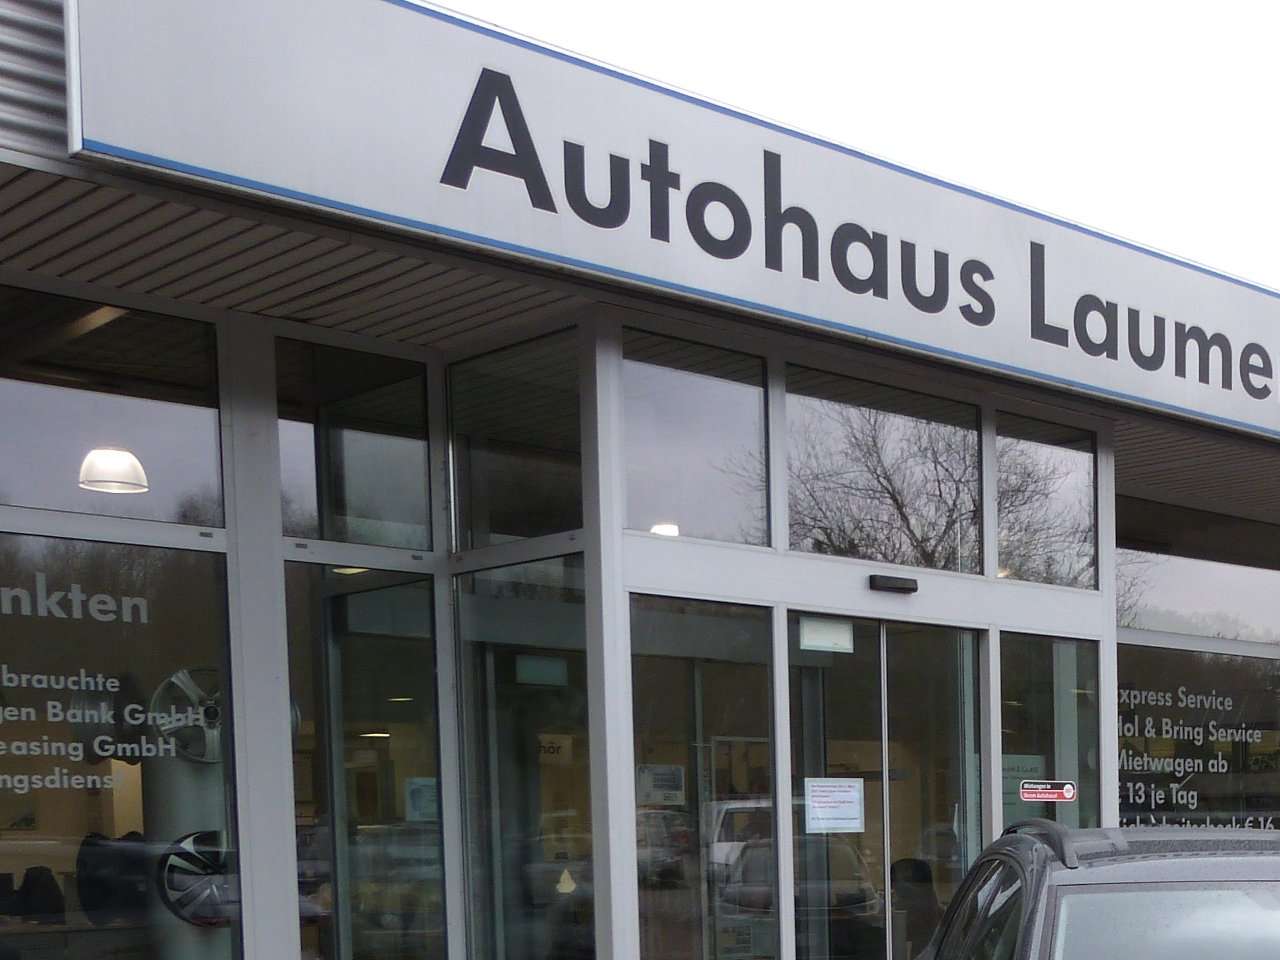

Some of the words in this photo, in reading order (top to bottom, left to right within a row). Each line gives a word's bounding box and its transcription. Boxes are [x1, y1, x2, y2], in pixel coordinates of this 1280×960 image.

[439, 67, 996, 327] Autohaus
[0, 572, 148, 623] nkten
[2, 664, 120, 692] brauchte
[1177, 686, 1232, 710] Service
[0, 705, 37, 725] en
[47, 700, 116, 724] Bank
[123, 703, 205, 727] GmbH
[1145, 717, 1156, 738] &
[1162, 718, 1203, 746] Bring
[1208, 720, 1263, 743] Service
[93, 735, 176, 757] GmbH
[1208, 751, 1228, 773] ab
[0, 766, 122, 794] ngsdiens
[1127, 782, 1146, 804] 13
[1150, 783, 1165, 809] je
[1169, 783, 1198, 809] Tag
